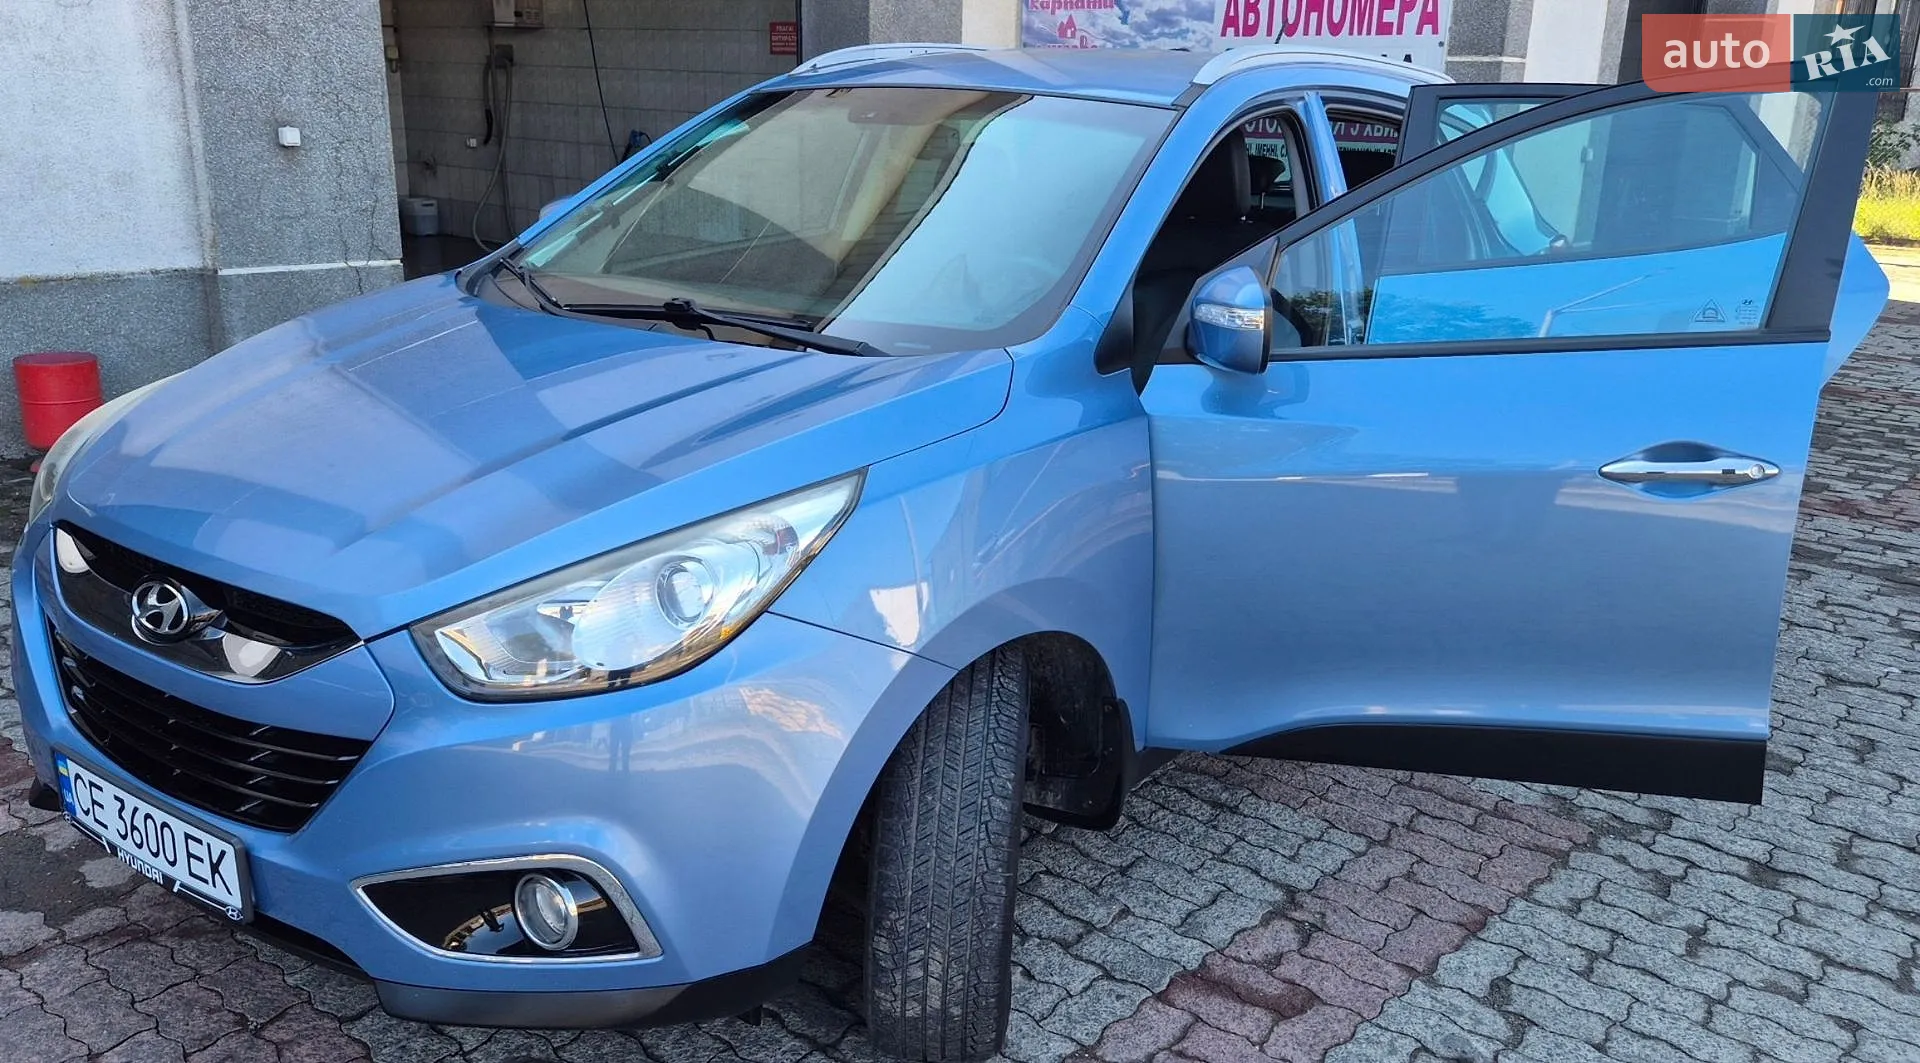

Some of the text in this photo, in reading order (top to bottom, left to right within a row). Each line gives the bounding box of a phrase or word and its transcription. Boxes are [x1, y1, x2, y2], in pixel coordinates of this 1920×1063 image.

[1220, 0, 1439, 37] АВТОНОМЕРА
[73, 772, 233, 896] CE 3600 EK
[117, 847, 164, 885] HYUNDAI
